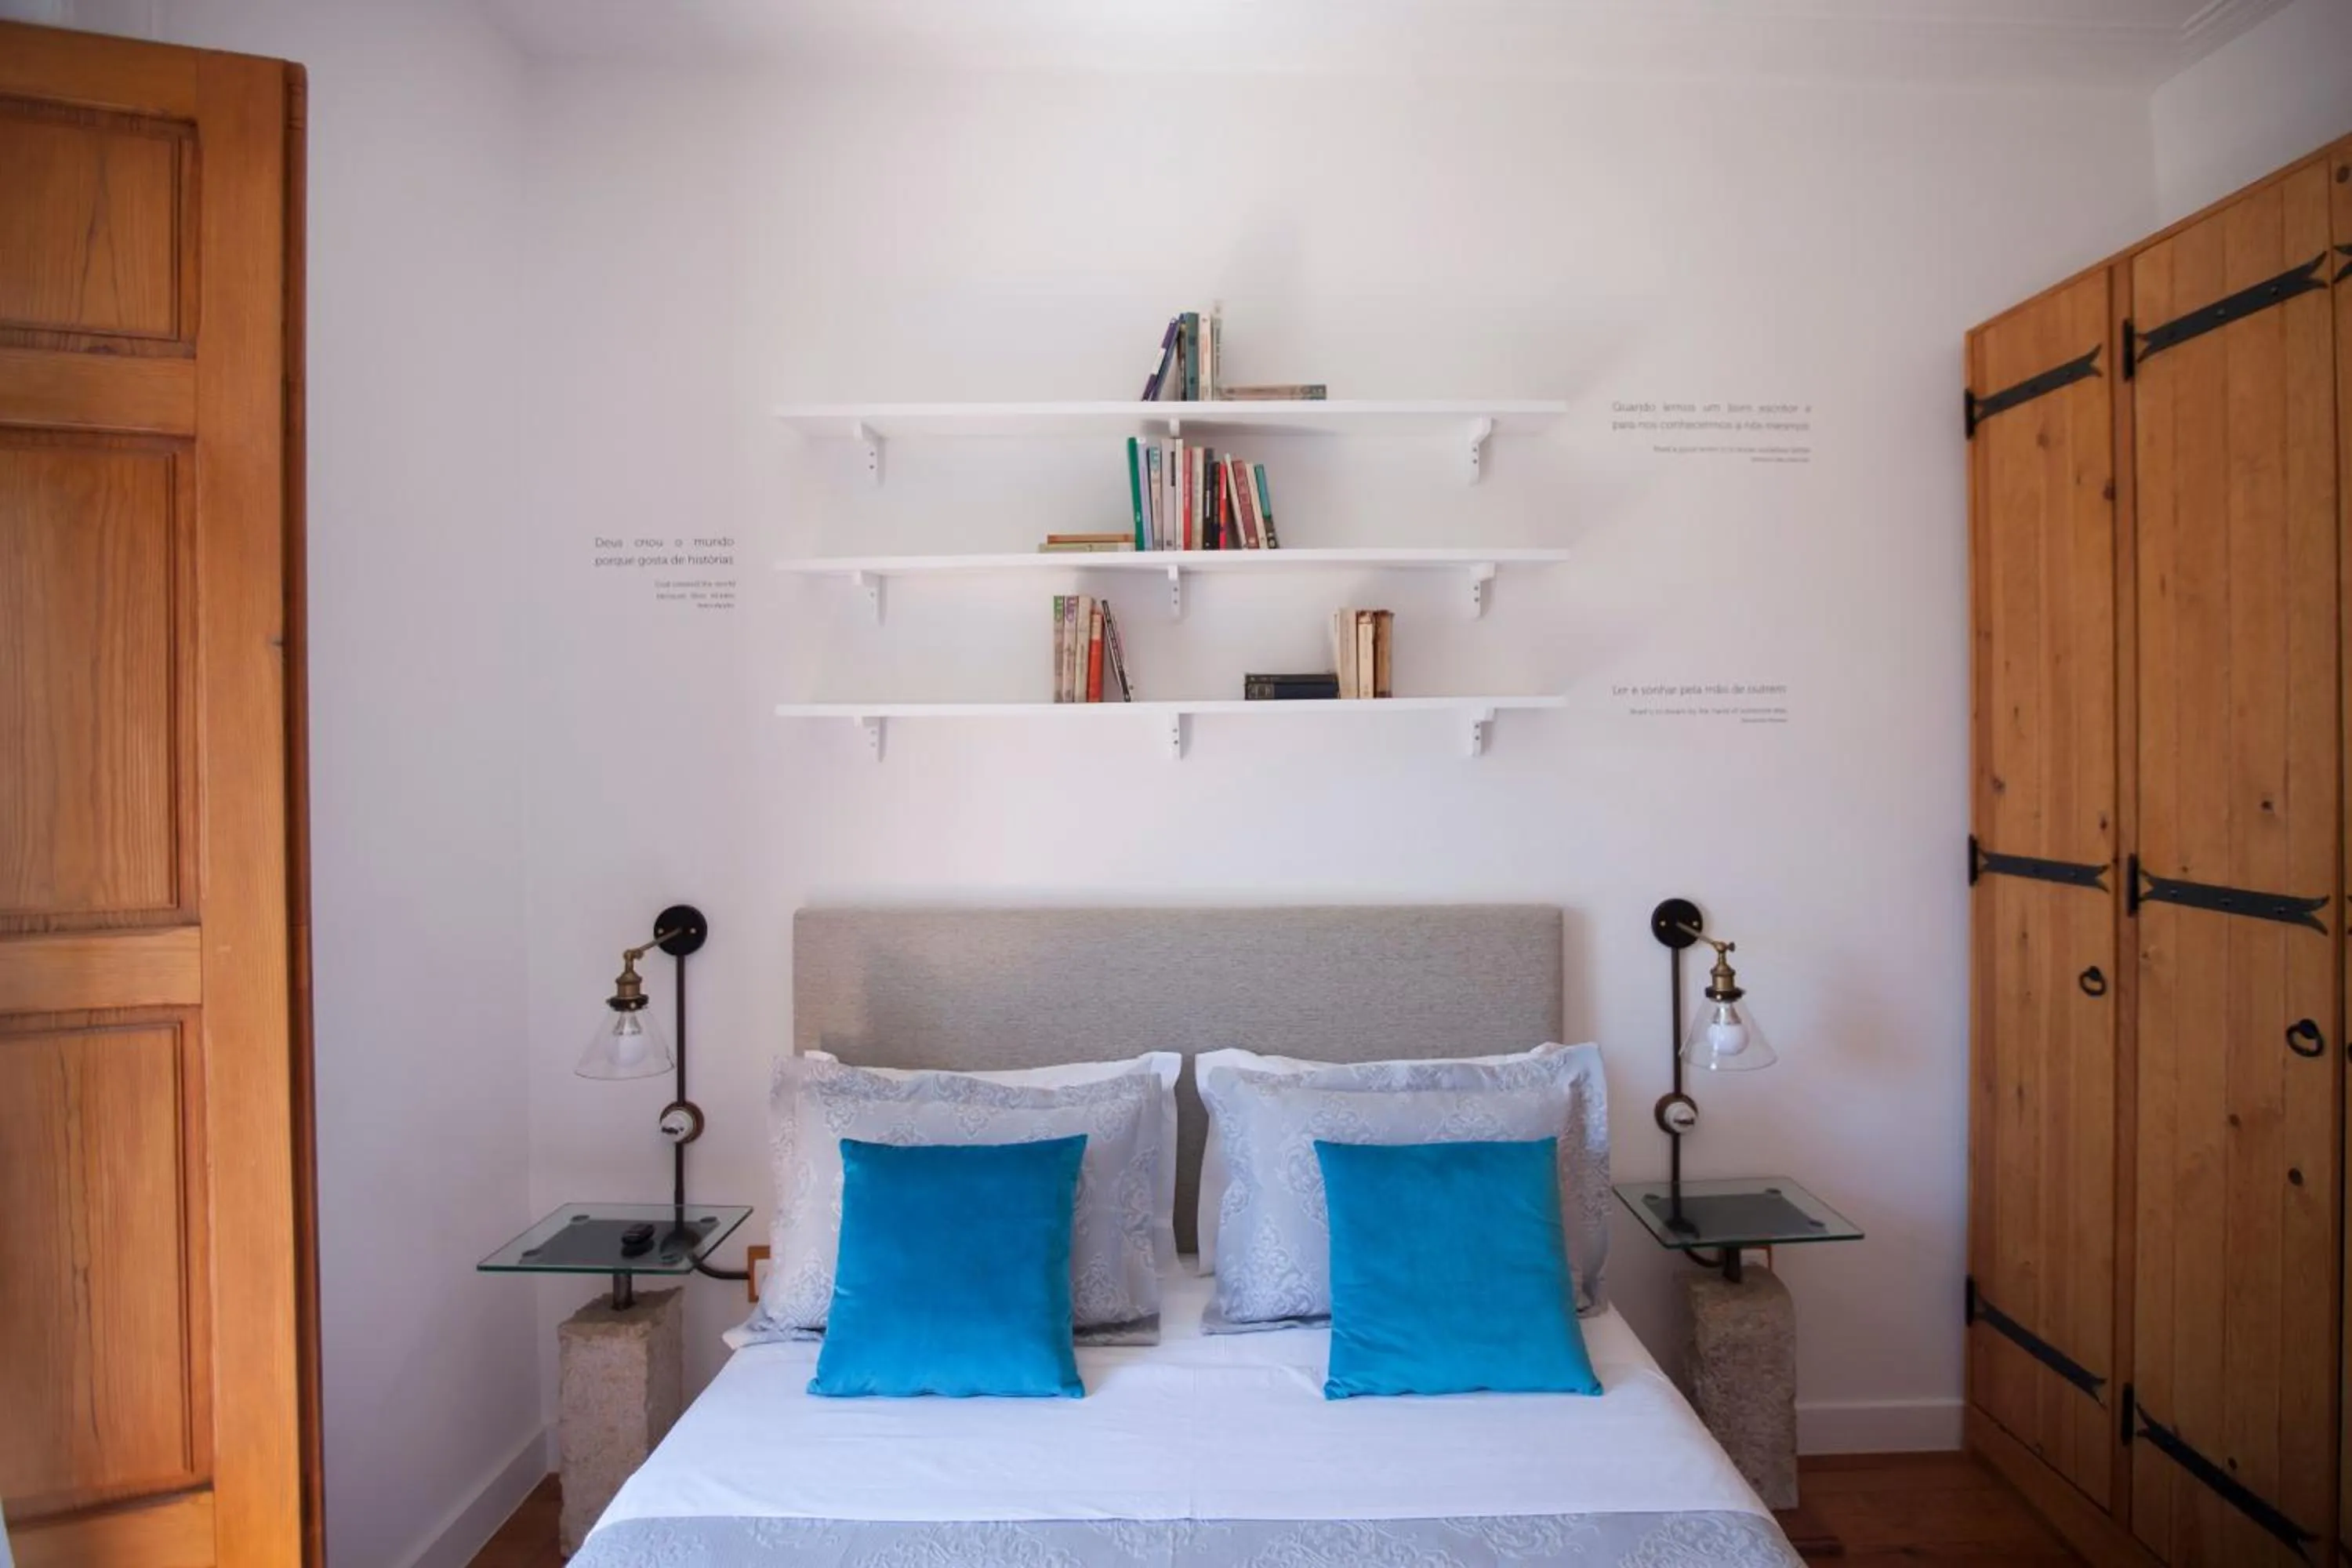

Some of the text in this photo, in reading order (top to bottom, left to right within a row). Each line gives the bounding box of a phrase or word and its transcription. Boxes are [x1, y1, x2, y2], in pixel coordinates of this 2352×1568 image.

[1703, 404, 1721, 412] um
[594, 536, 735, 548] Deus criou o mundo
[594, 554, 733, 567] porque gosta de histórias
[1679, 685, 1702, 697] pela
